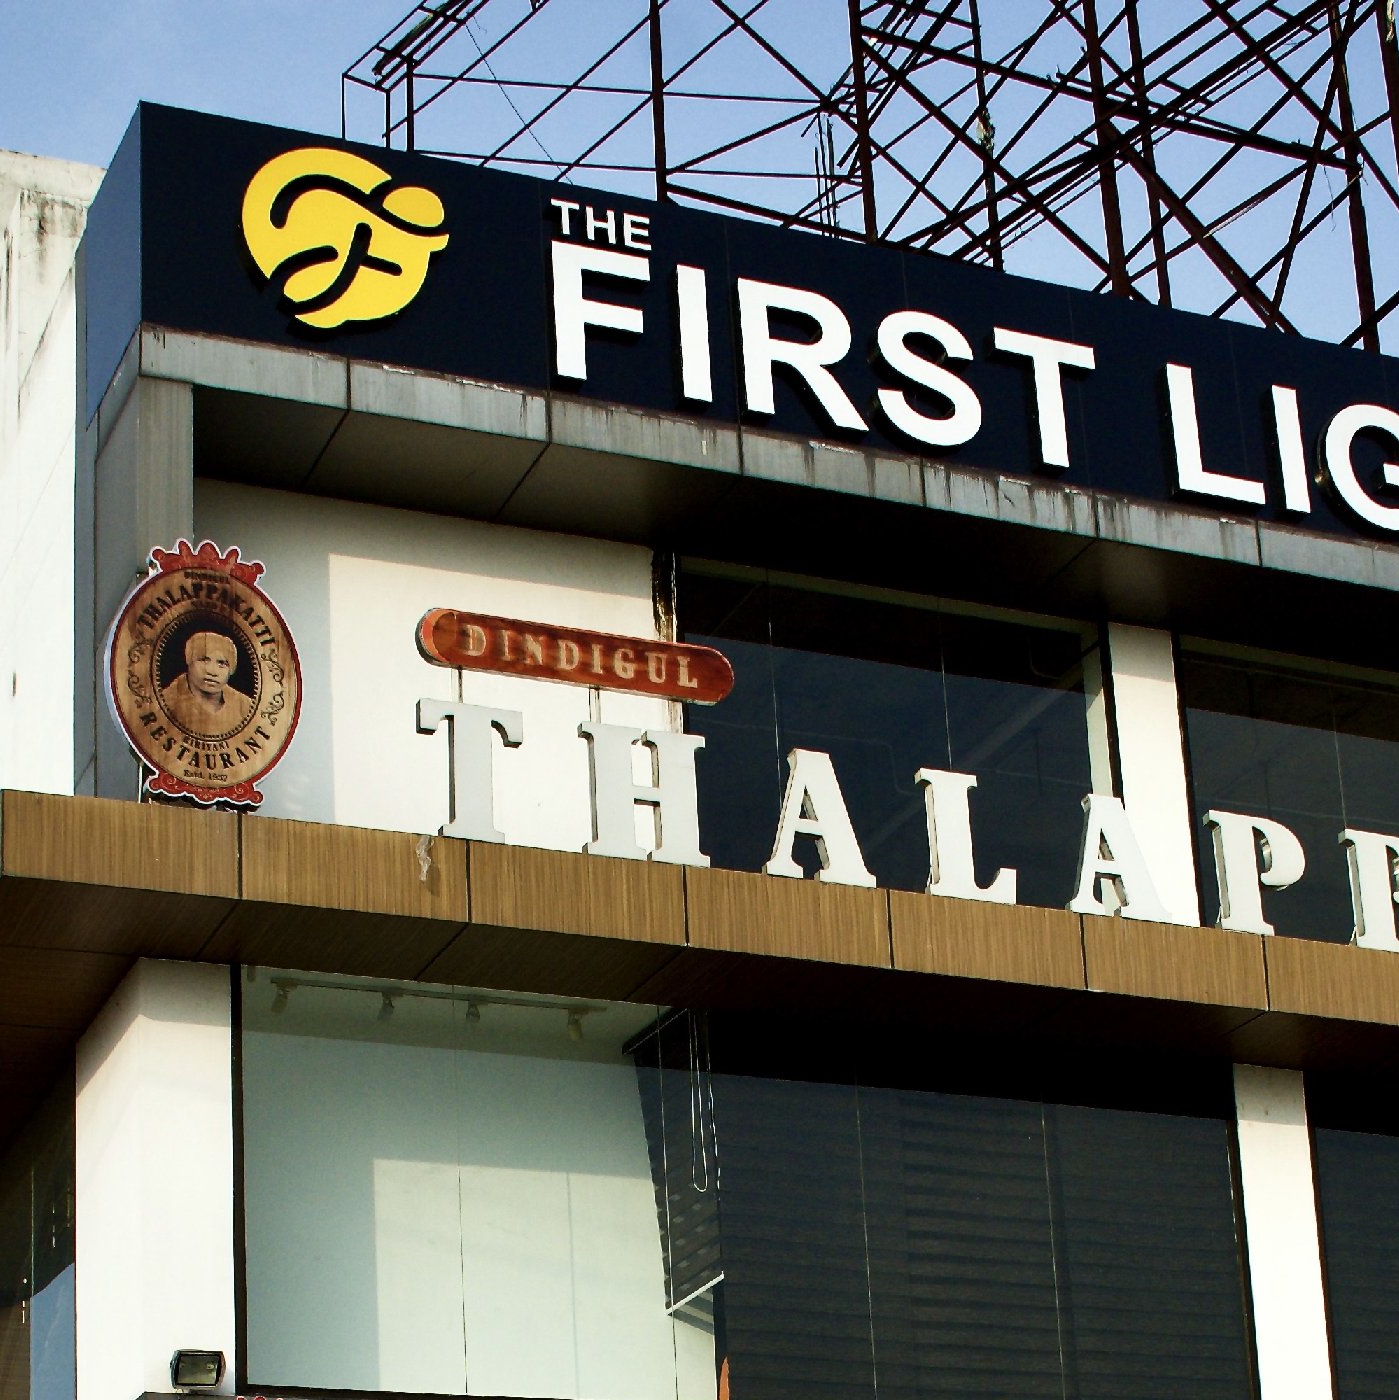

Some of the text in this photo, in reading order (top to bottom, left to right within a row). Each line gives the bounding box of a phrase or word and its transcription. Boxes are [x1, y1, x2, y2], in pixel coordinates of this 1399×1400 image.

[549, 198, 650, 251] THE
[549, 239, 1097, 473] FIRST
[461, 623, 700, 690] DINDIGUL
[140, 711, 271, 771] RESTAURANT
